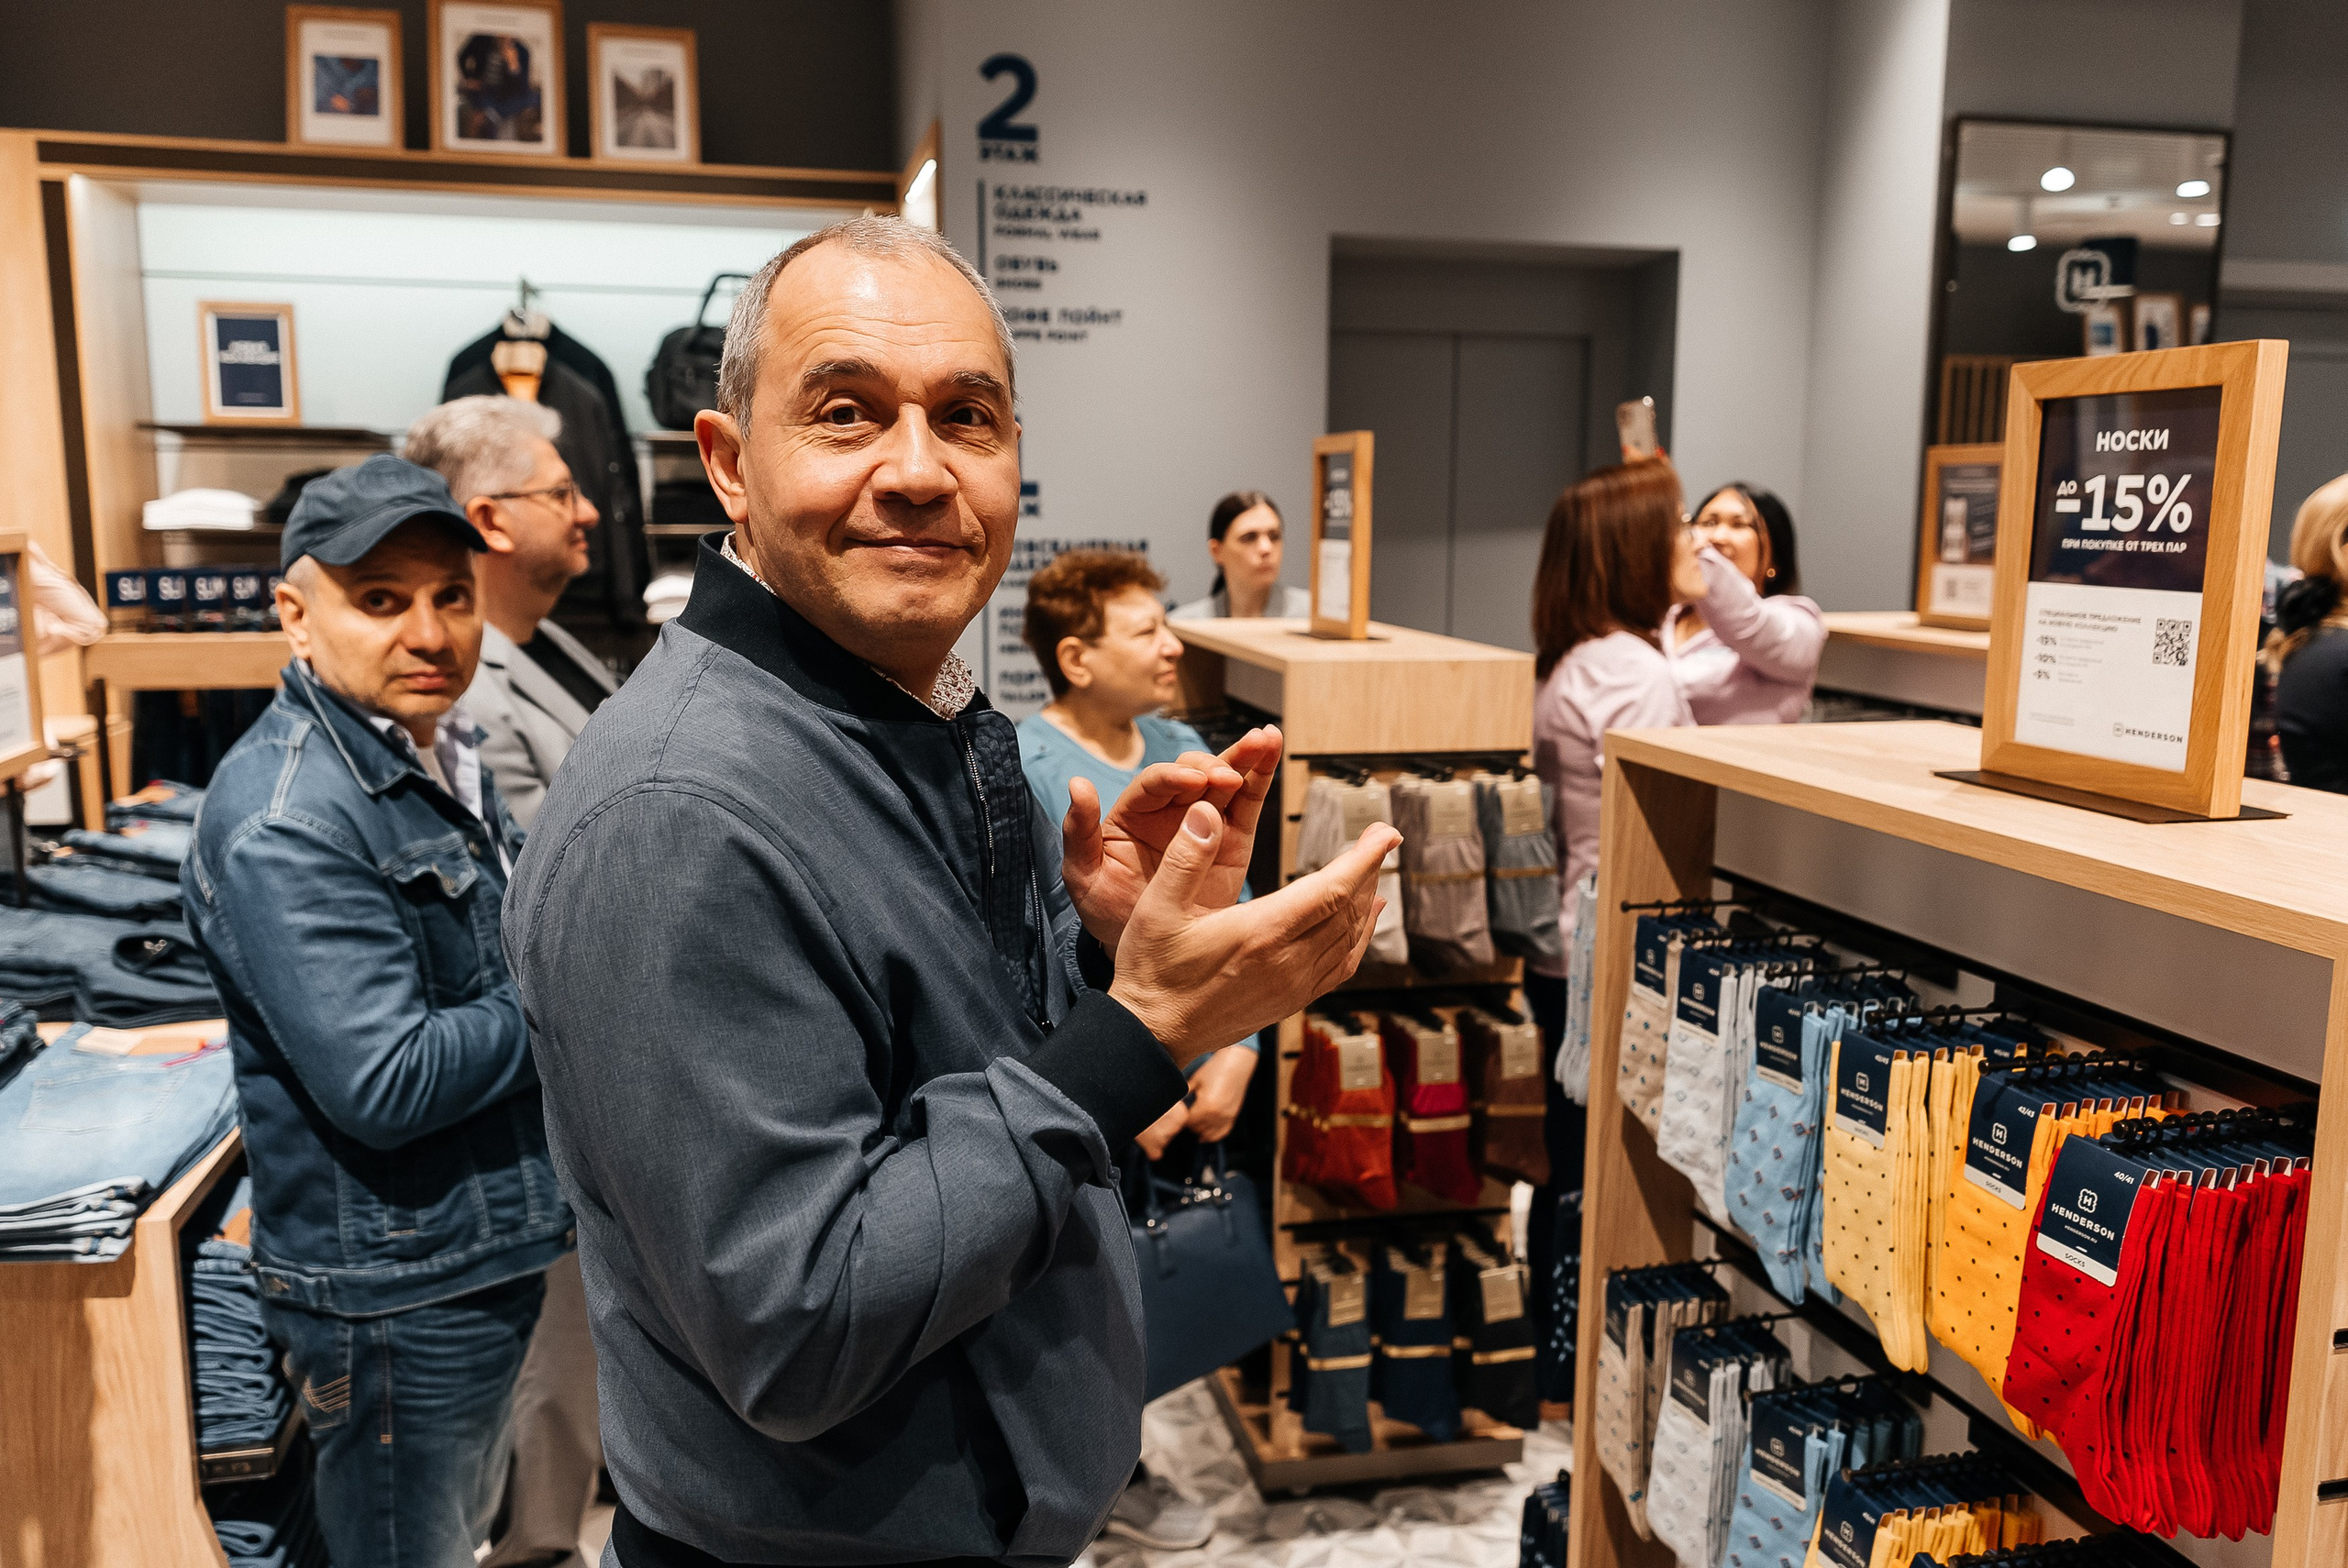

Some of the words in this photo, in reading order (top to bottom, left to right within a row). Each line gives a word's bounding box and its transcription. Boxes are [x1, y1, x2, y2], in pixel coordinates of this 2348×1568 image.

[977, 52, 1037, 142] 2
[993, 186, 1147, 207] КЛАССИЧЕСКАЯ
[993, 203, 1081, 223] ОДЕЖДА
[994, 254, 1058, 272] ОБУВЬ
[1004, 305, 1048, 323] ОФЕ
[2096, 428, 2170, 452] НОСКИ
[2056, 480, 2077, 497] ДО
[2054, 473, 2193, 534] -15%
[2061, 537, 2080, 549] ПРИ
[2081, 538, 2124, 551] ПОКУПКЕ
[2125, 540, 2140, 551] ОТ
[2141, 541, 2165, 553] ТРЕХ
[2165, 542, 2187, 553] ПАР
[2125, 728, 2183, 743] HENDERSON
[1840, 1088, 1884, 1112] HENDERSON
[1972, 1137, 2023, 1169] HENDERSON
[2113, 1171, 2135, 1185] 40/41
[2051, 1203, 2115, 1242] HENDERSON
[2064, 1225, 2099, 1244] HENDERSON.RU
[2065, 1252, 2086, 1268] SOCKS
